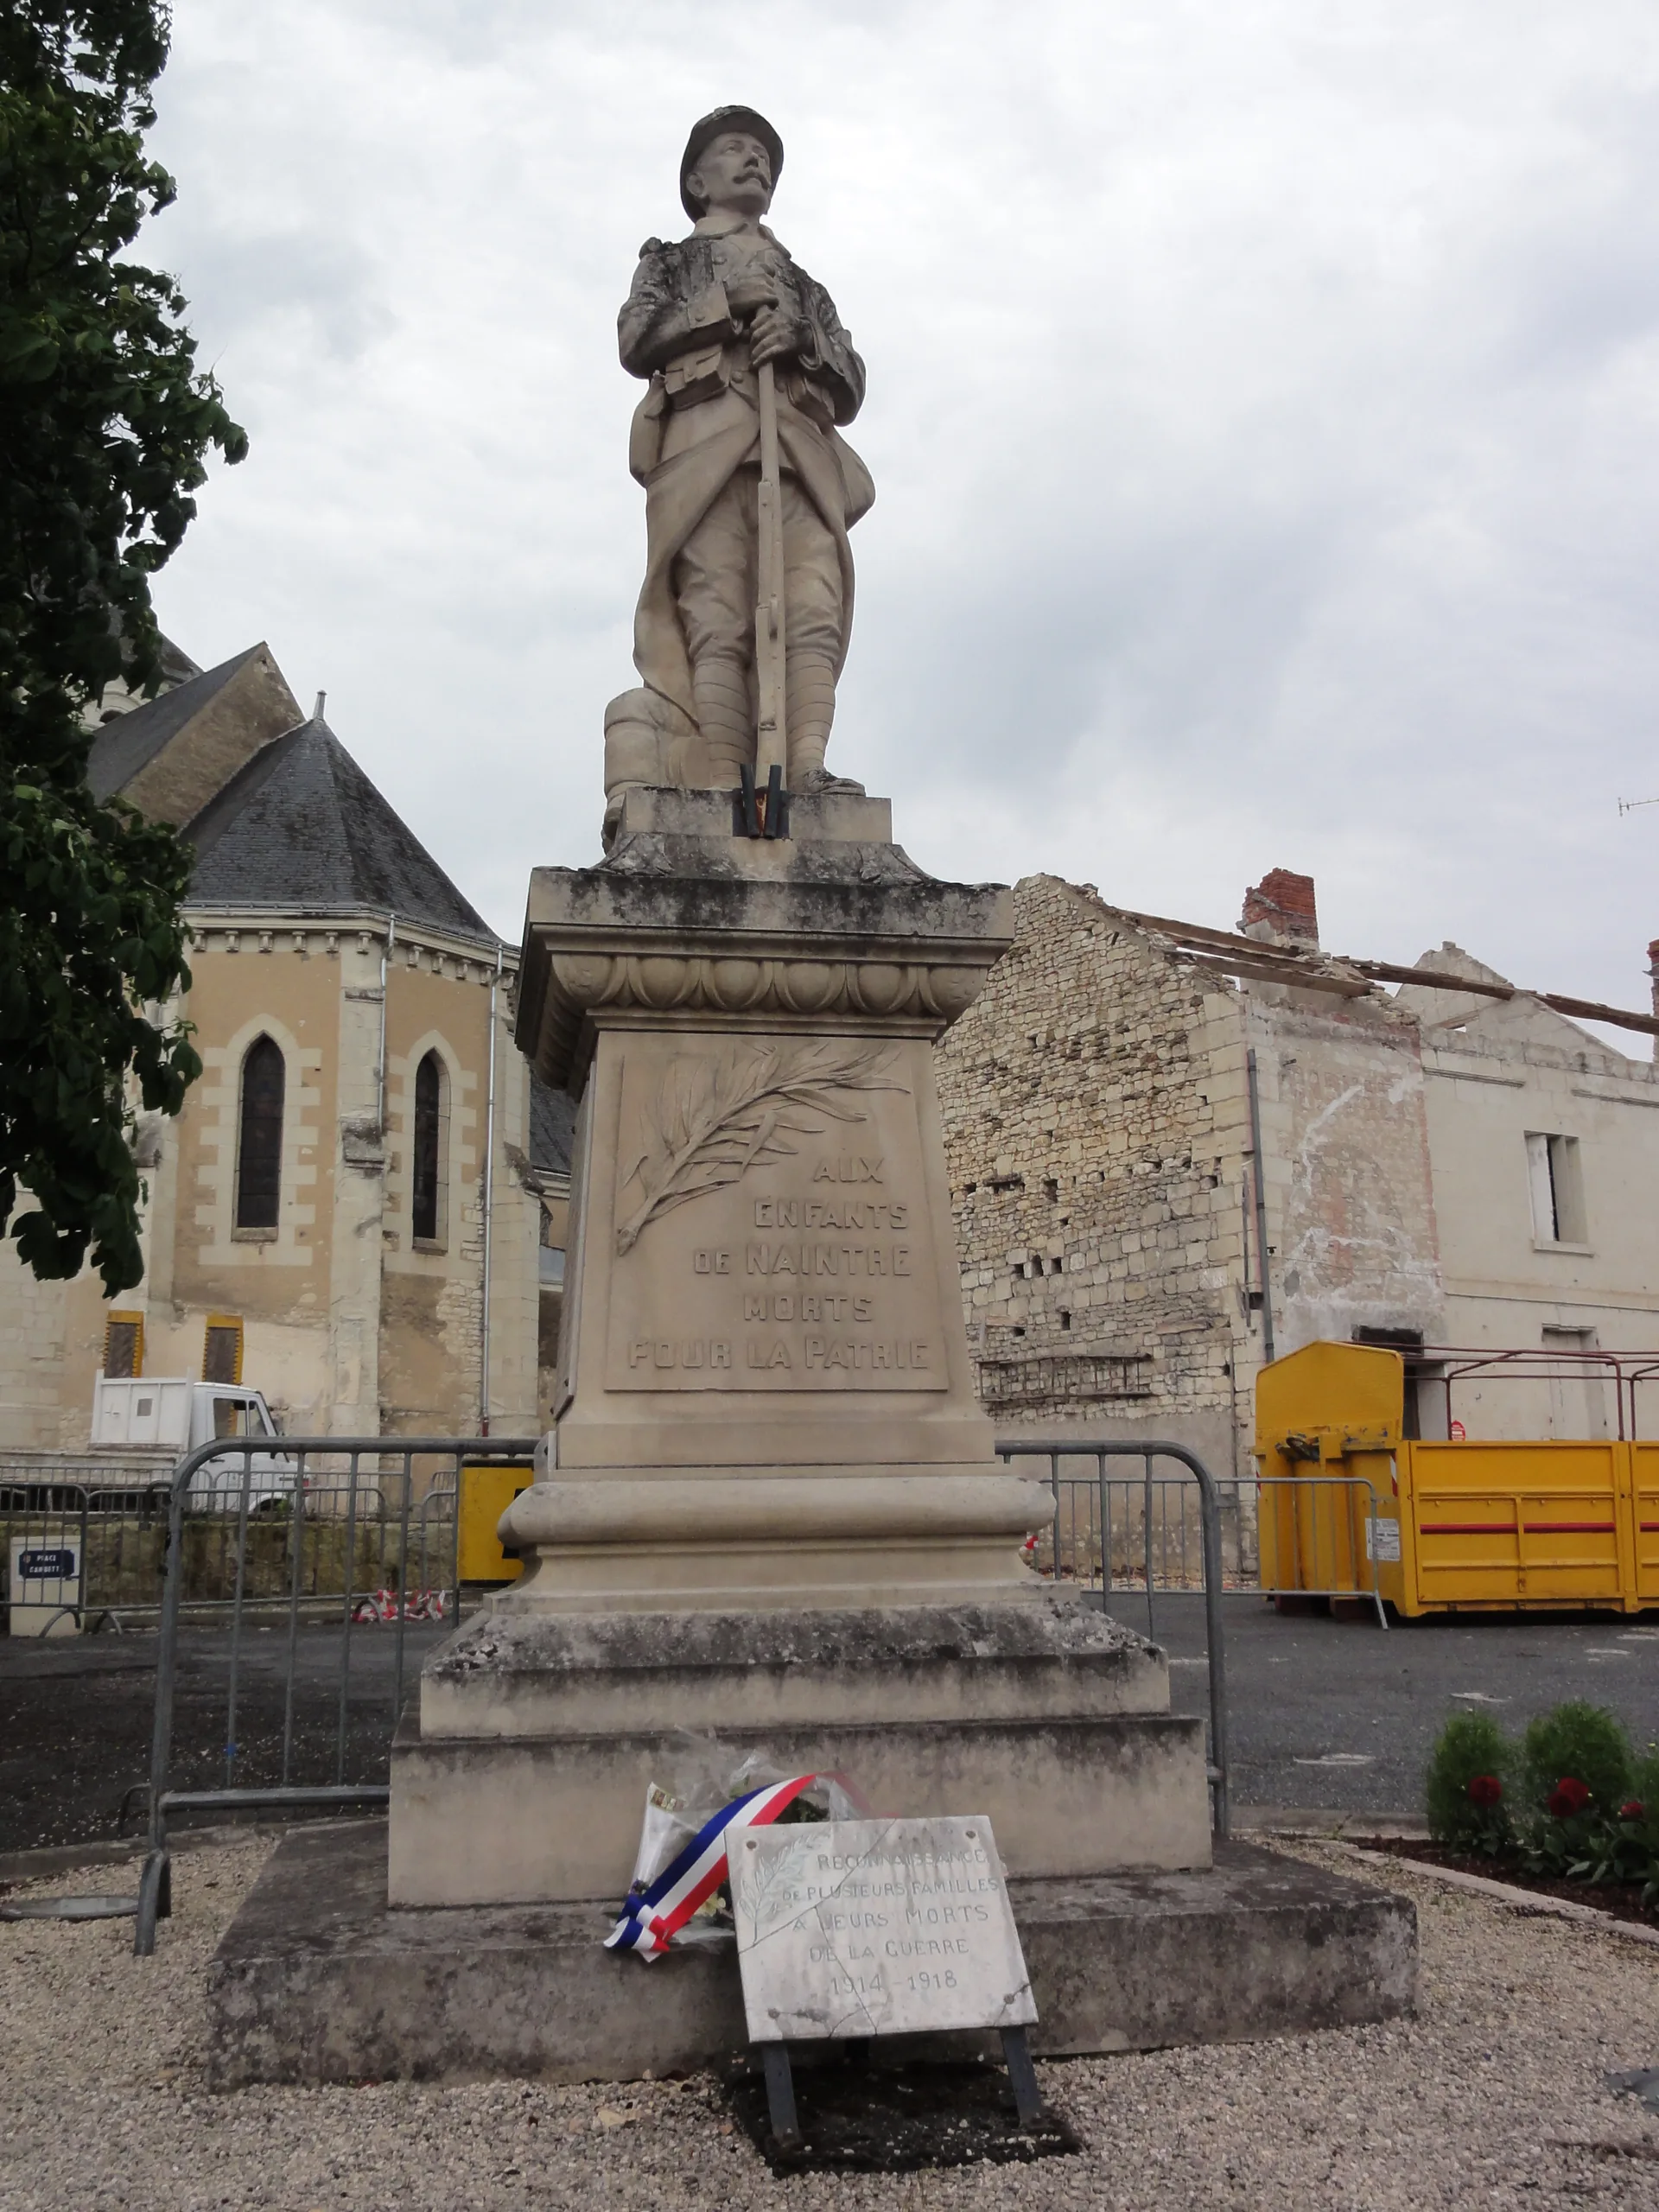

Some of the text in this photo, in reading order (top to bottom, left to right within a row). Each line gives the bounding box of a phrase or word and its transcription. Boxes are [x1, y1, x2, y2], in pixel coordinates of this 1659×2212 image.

[812, 1157, 885, 1184] AUX
[754, 1199, 908, 1230] ENFANTS
[694, 1244, 912, 1276] DE NAINTRE
[743, 1294, 874, 1322] MORTS
[630, 1337, 929, 1370] POUR LA PATRIE
[817, 1848, 988, 1871] RECONNAISSANCE
[783, 1878, 999, 1902] DE PLUSIEURS FAMILLES
[792, 1904, 989, 1932] A LEURS MORTS
[809, 1938, 970, 1963] DE LA GUERRE
